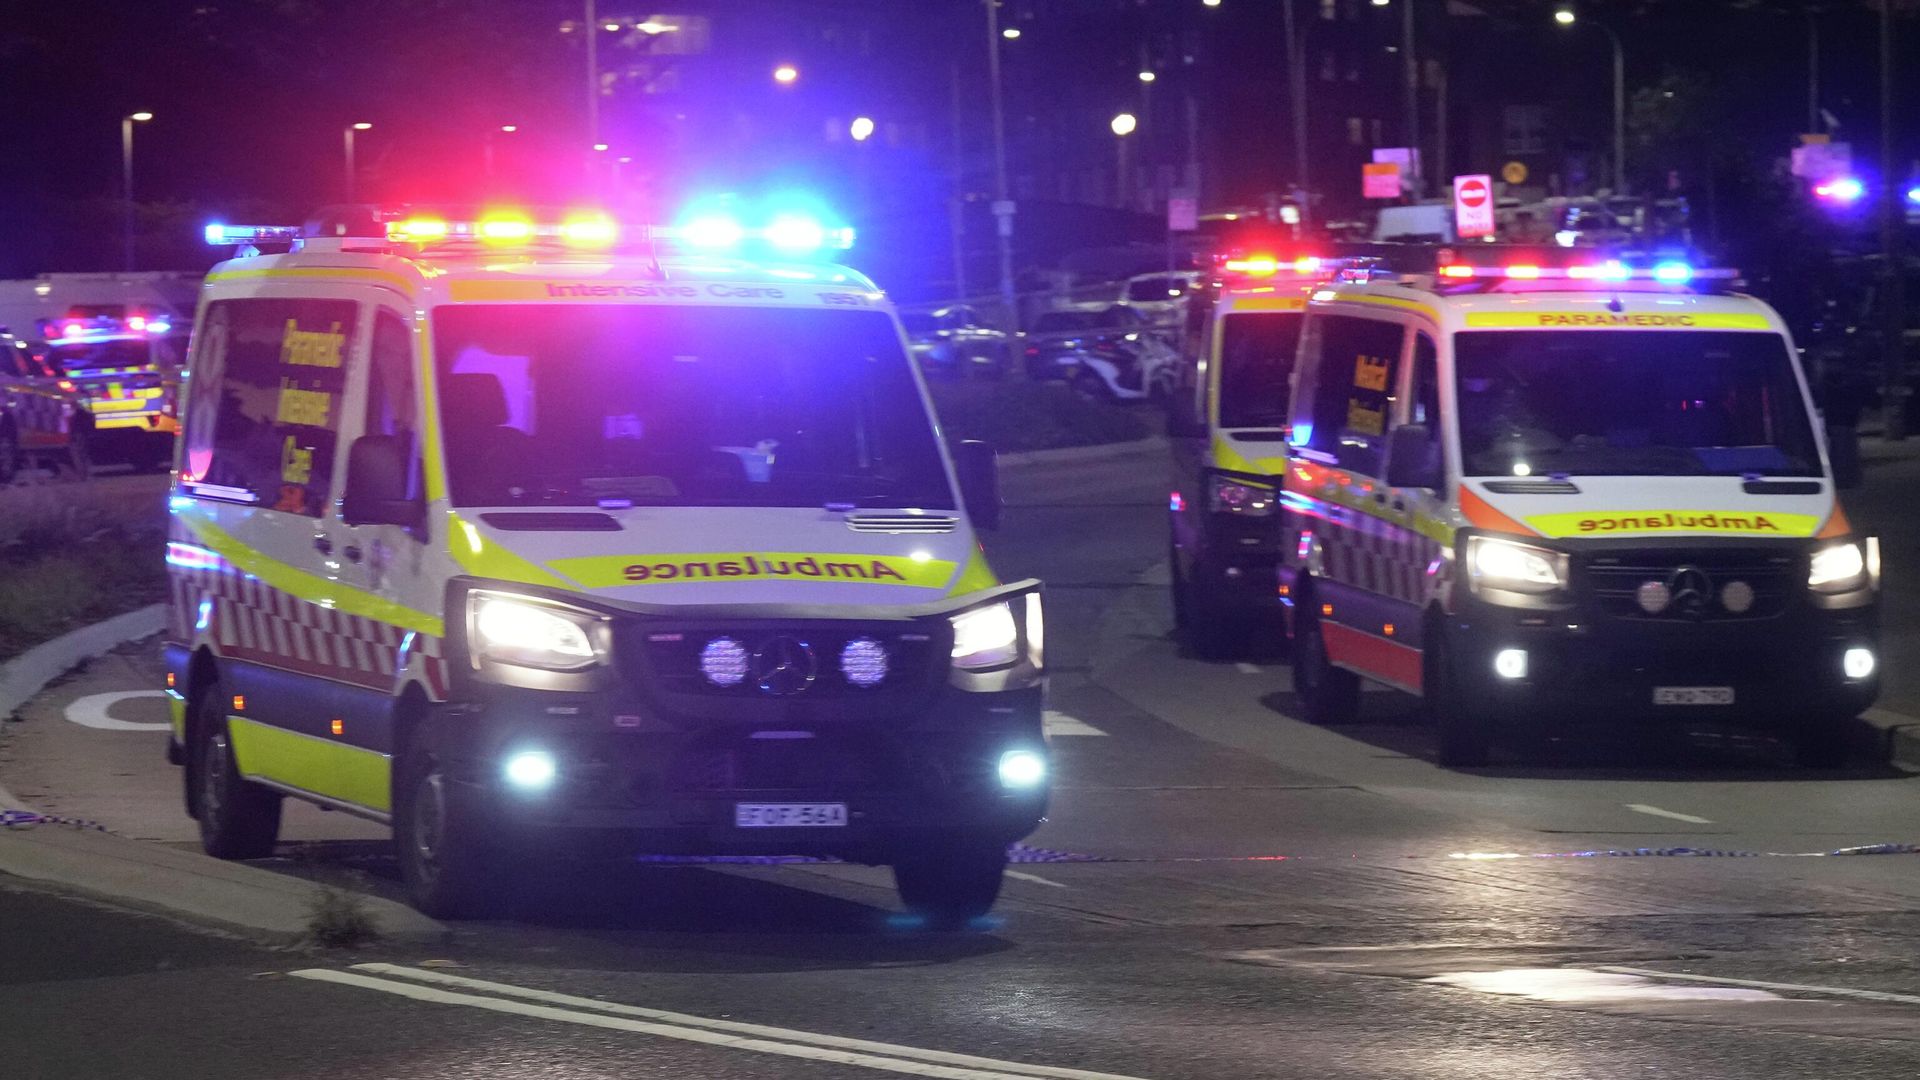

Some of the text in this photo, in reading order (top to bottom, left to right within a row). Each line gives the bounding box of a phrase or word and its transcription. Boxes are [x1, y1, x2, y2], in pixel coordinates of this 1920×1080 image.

[545, 283, 785, 300] Intensive Care
[1538, 314, 1695, 327] PARAMEDIC
